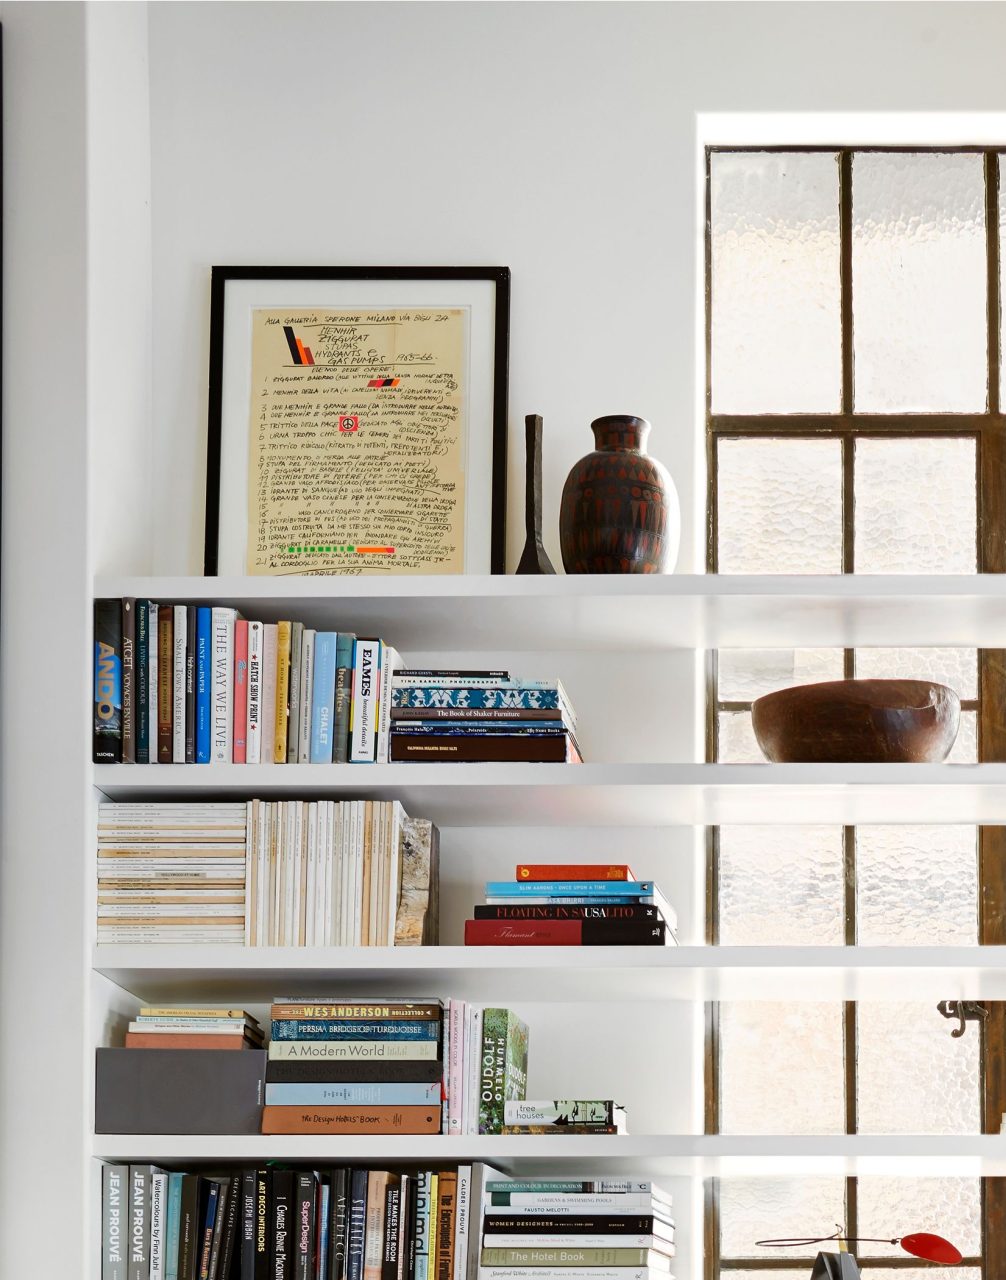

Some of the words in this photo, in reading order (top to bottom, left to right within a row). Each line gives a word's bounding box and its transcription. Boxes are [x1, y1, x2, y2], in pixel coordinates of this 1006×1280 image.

[123, 636, 132, 669] ATGET
[216, 625, 227, 653] THE
[97, 642, 115, 720] ANDO
[216, 658, 226, 686] WAY
[251, 661, 259, 683] HATCH
[361, 649, 372, 697] EAMES
[123, 673, 131, 707] VOYAGES
[216, 691, 226, 712] WE
[250, 685, 258, 701] SHOW
[250, 704, 258, 723] PRINT
[320, 707, 329, 744] CHALET
[494, 710, 520, 718] Furniture
[216, 717, 226, 747] LIVE
[304, 1008, 328, 1017] WES
[330, 1007, 389, 1017] ANDERSON
[288, 1046, 297, 1056] A
[300, 1045, 346, 1056] Modern
[348, 1044, 385, 1056] World
[516, 1110, 544, 1119] houses
[109, 1172, 120, 1206] JEAN
[133, 1172, 144, 1206] JEAN
[442, 1195, 453, 1206] The
[153, 1179, 162, 1228] Watercolours
[152, 1229, 160, 1238] by
[257, 1216, 265, 1252] INTERIORS
[299, 1201, 310, 1253] SuperDesign
[510, 1252, 528, 1261] The
[531, 1252, 557, 1261] Hotel
[560, 1252, 585, 1261] Book
